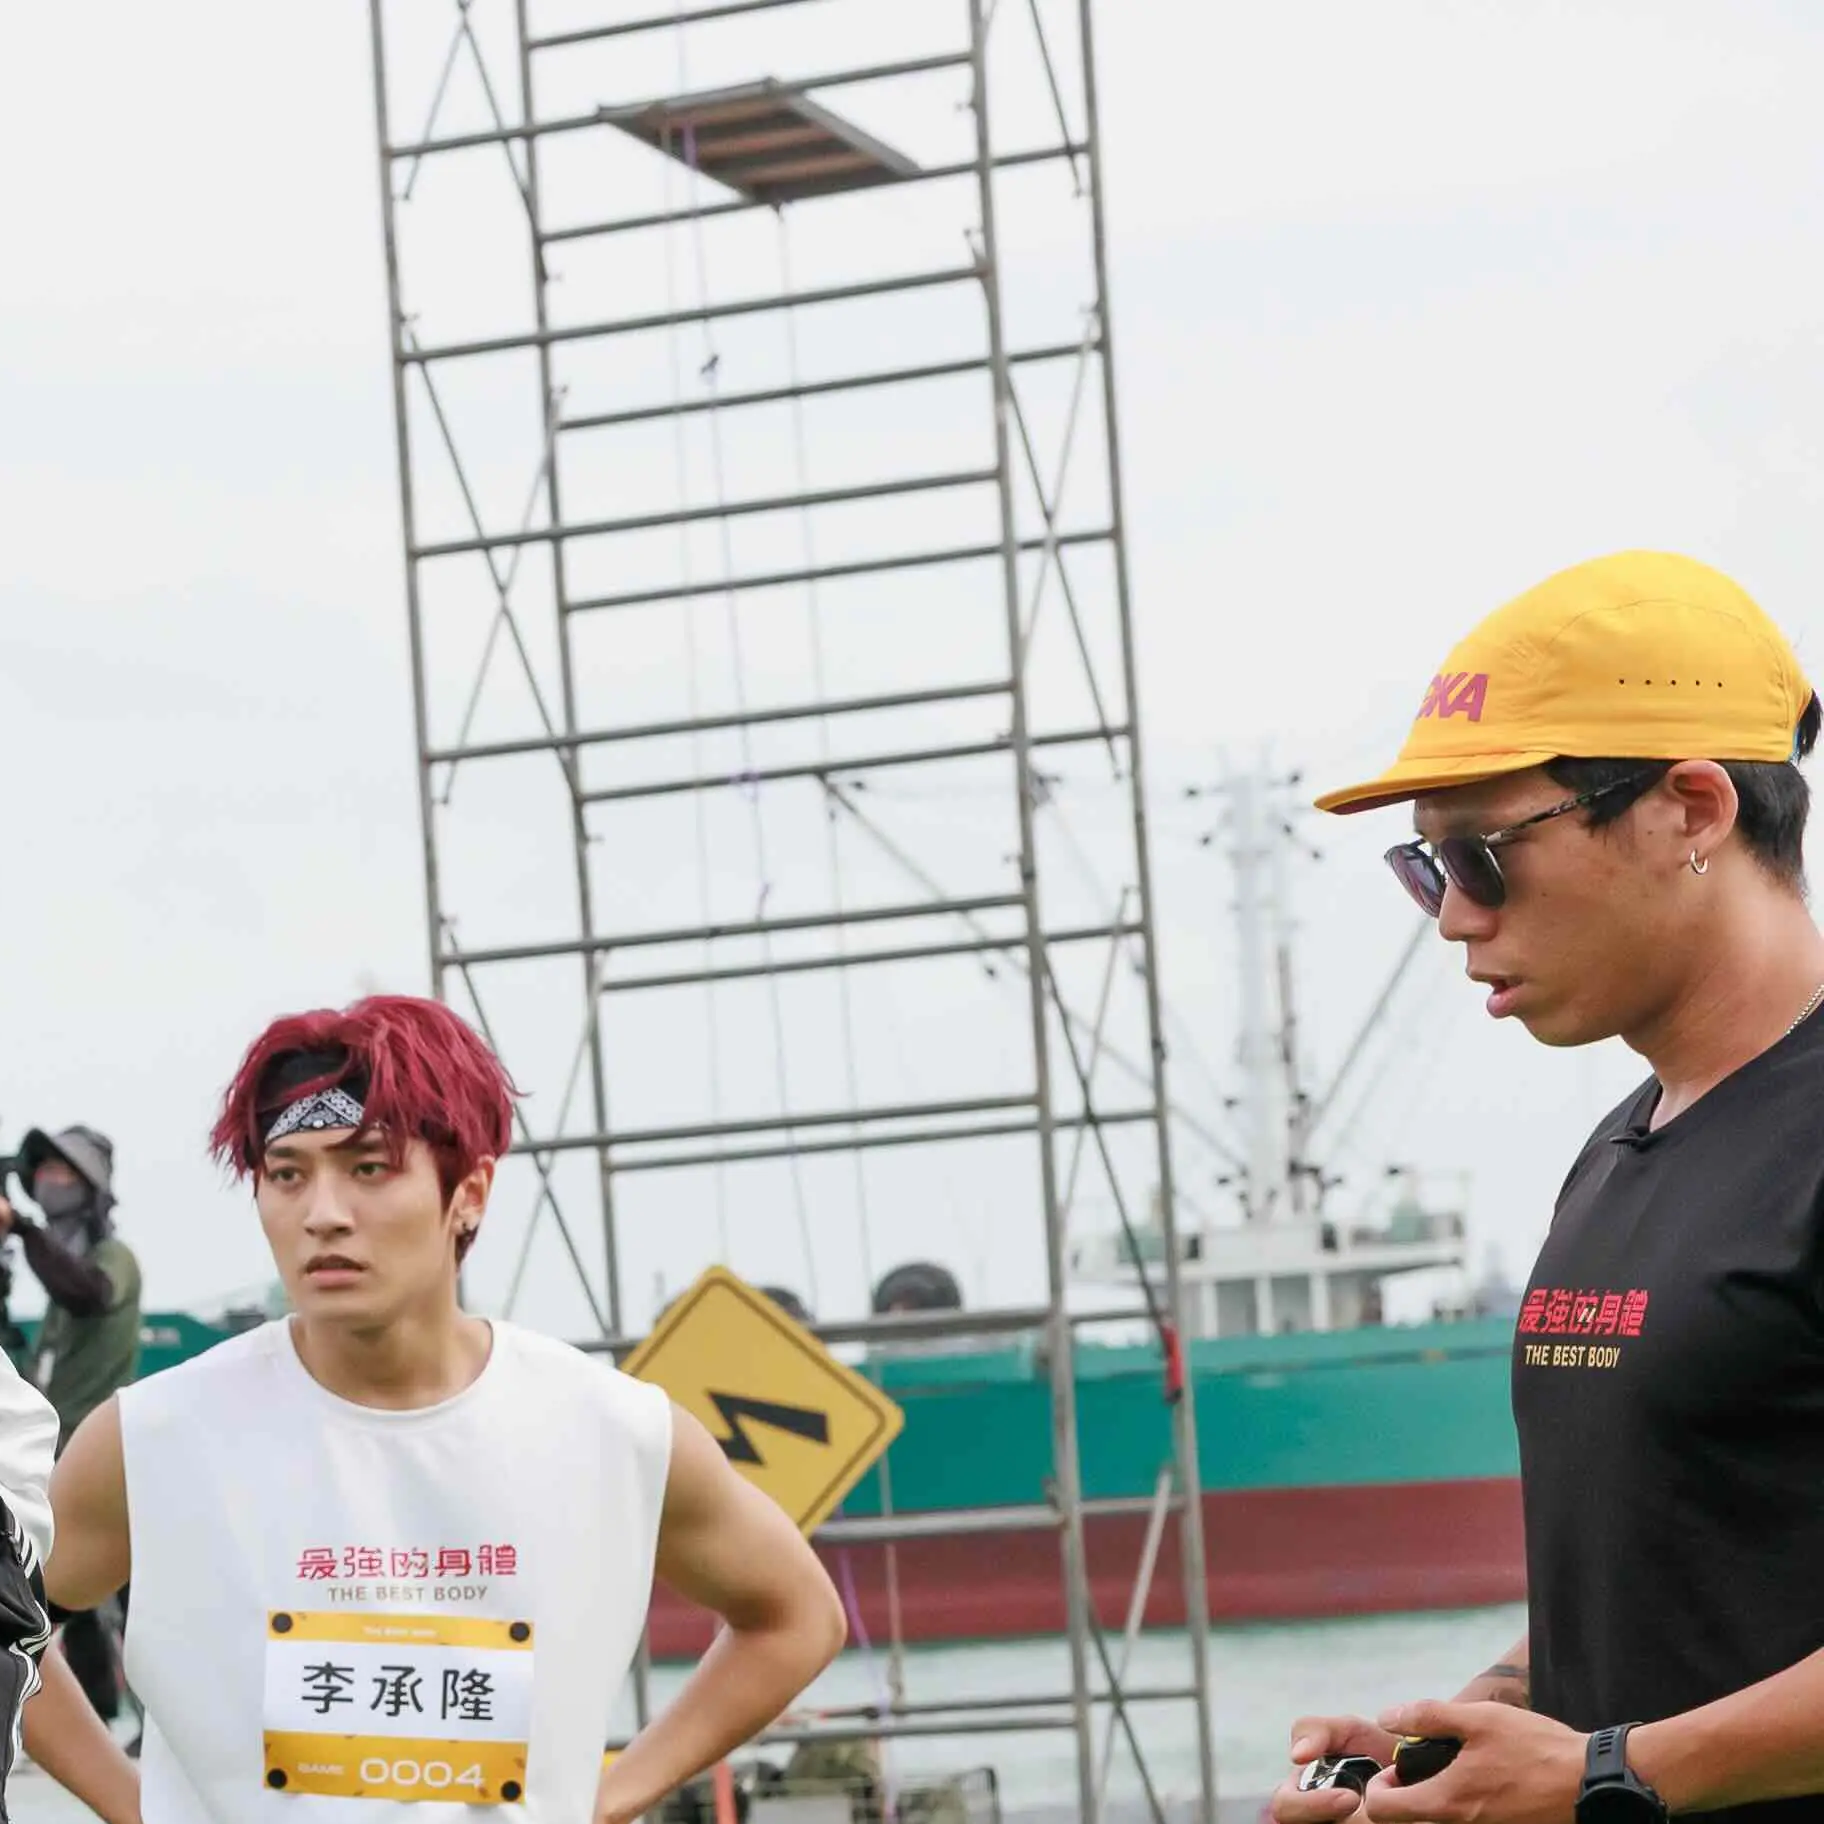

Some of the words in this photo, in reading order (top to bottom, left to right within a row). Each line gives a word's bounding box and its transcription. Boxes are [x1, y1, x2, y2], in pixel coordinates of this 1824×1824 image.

[1519, 1288, 1649, 1336] 最強的身體
[1525, 1344, 1551, 1366] THE
[1552, 1345, 1586, 1367] BEST
[1587, 1346, 1621, 1369] BODY
[296, 1544, 517, 1580] 最強的身體
[328, 1585, 367, 1602] THE
[375, 1585, 425, 1602] BEST
[434, 1585, 488, 1602] BODY
[301, 1660, 495, 1721] 李承隆
[359, 1757, 485, 1788] 0004
